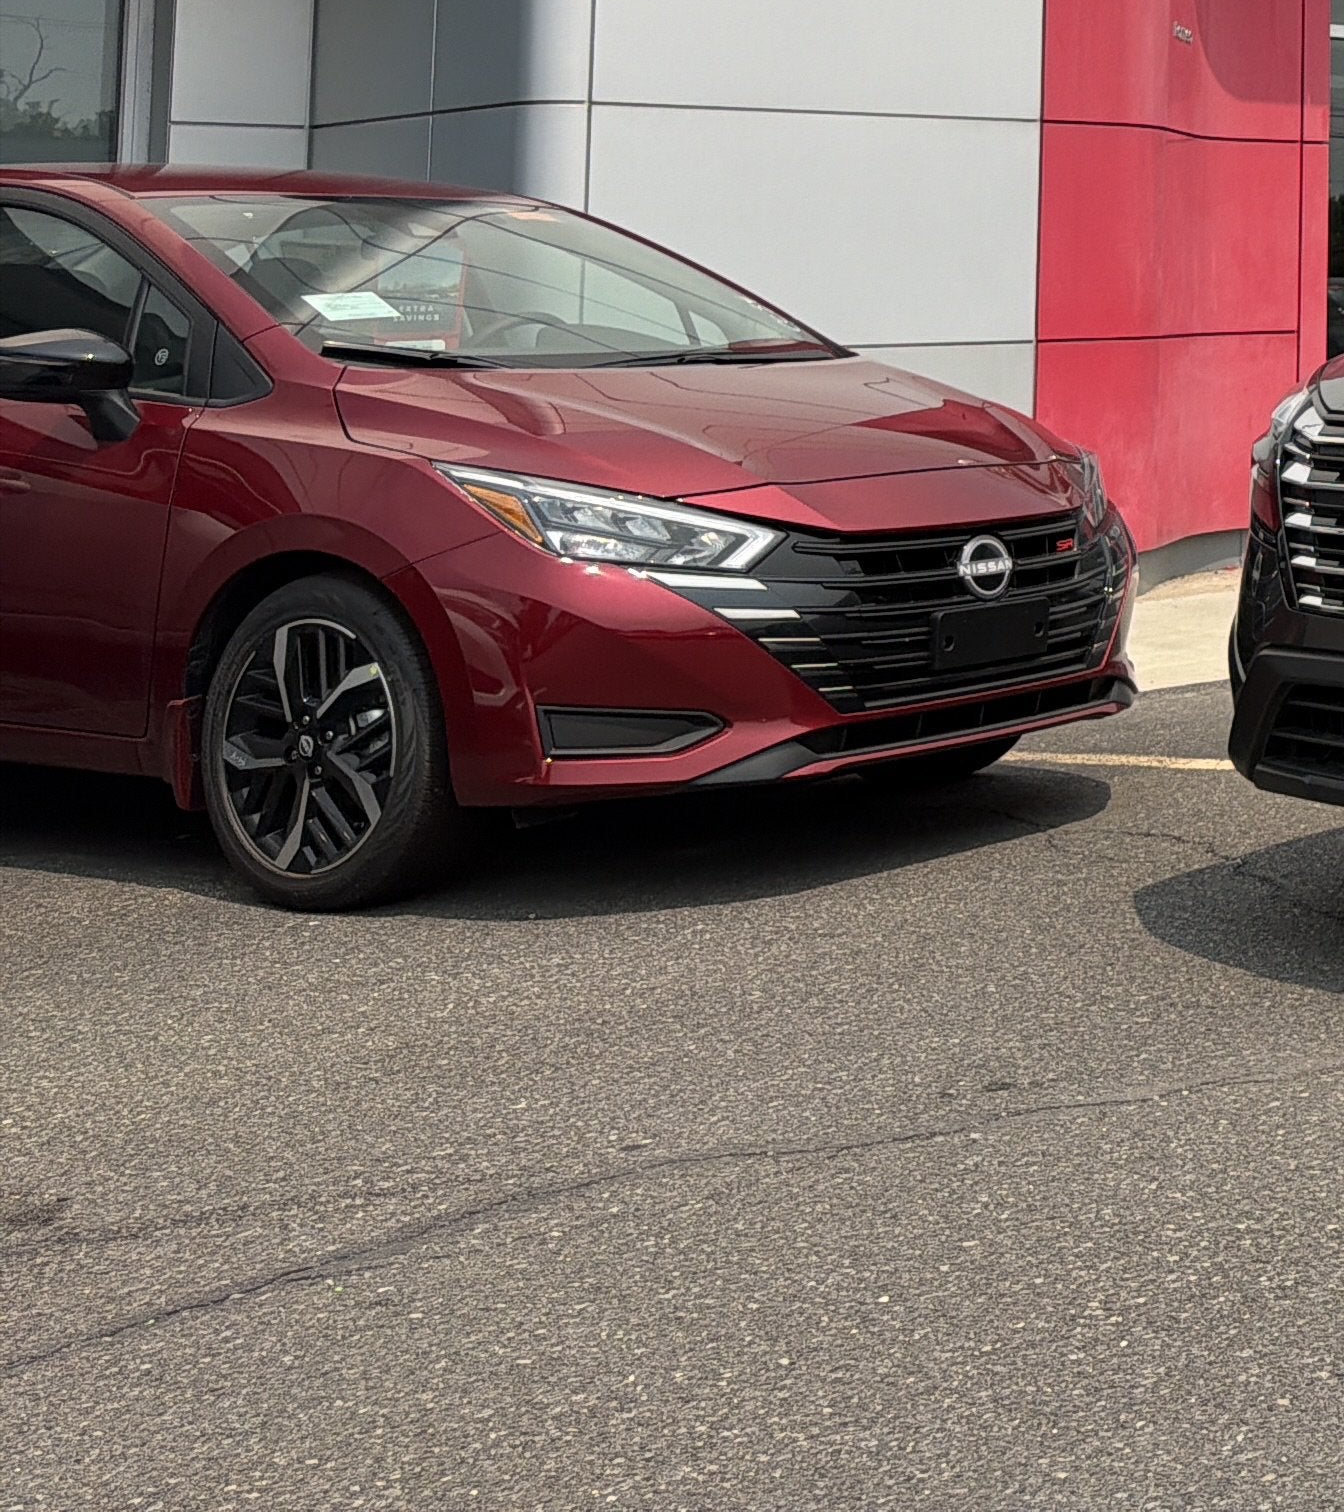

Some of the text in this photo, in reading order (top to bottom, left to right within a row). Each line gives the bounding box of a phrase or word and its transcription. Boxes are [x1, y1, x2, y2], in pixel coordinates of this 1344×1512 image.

[393, 314, 440, 322] SAVINGS
[1056, 538, 1073, 552] SR
[959, 560, 1012, 575] NISSAN
